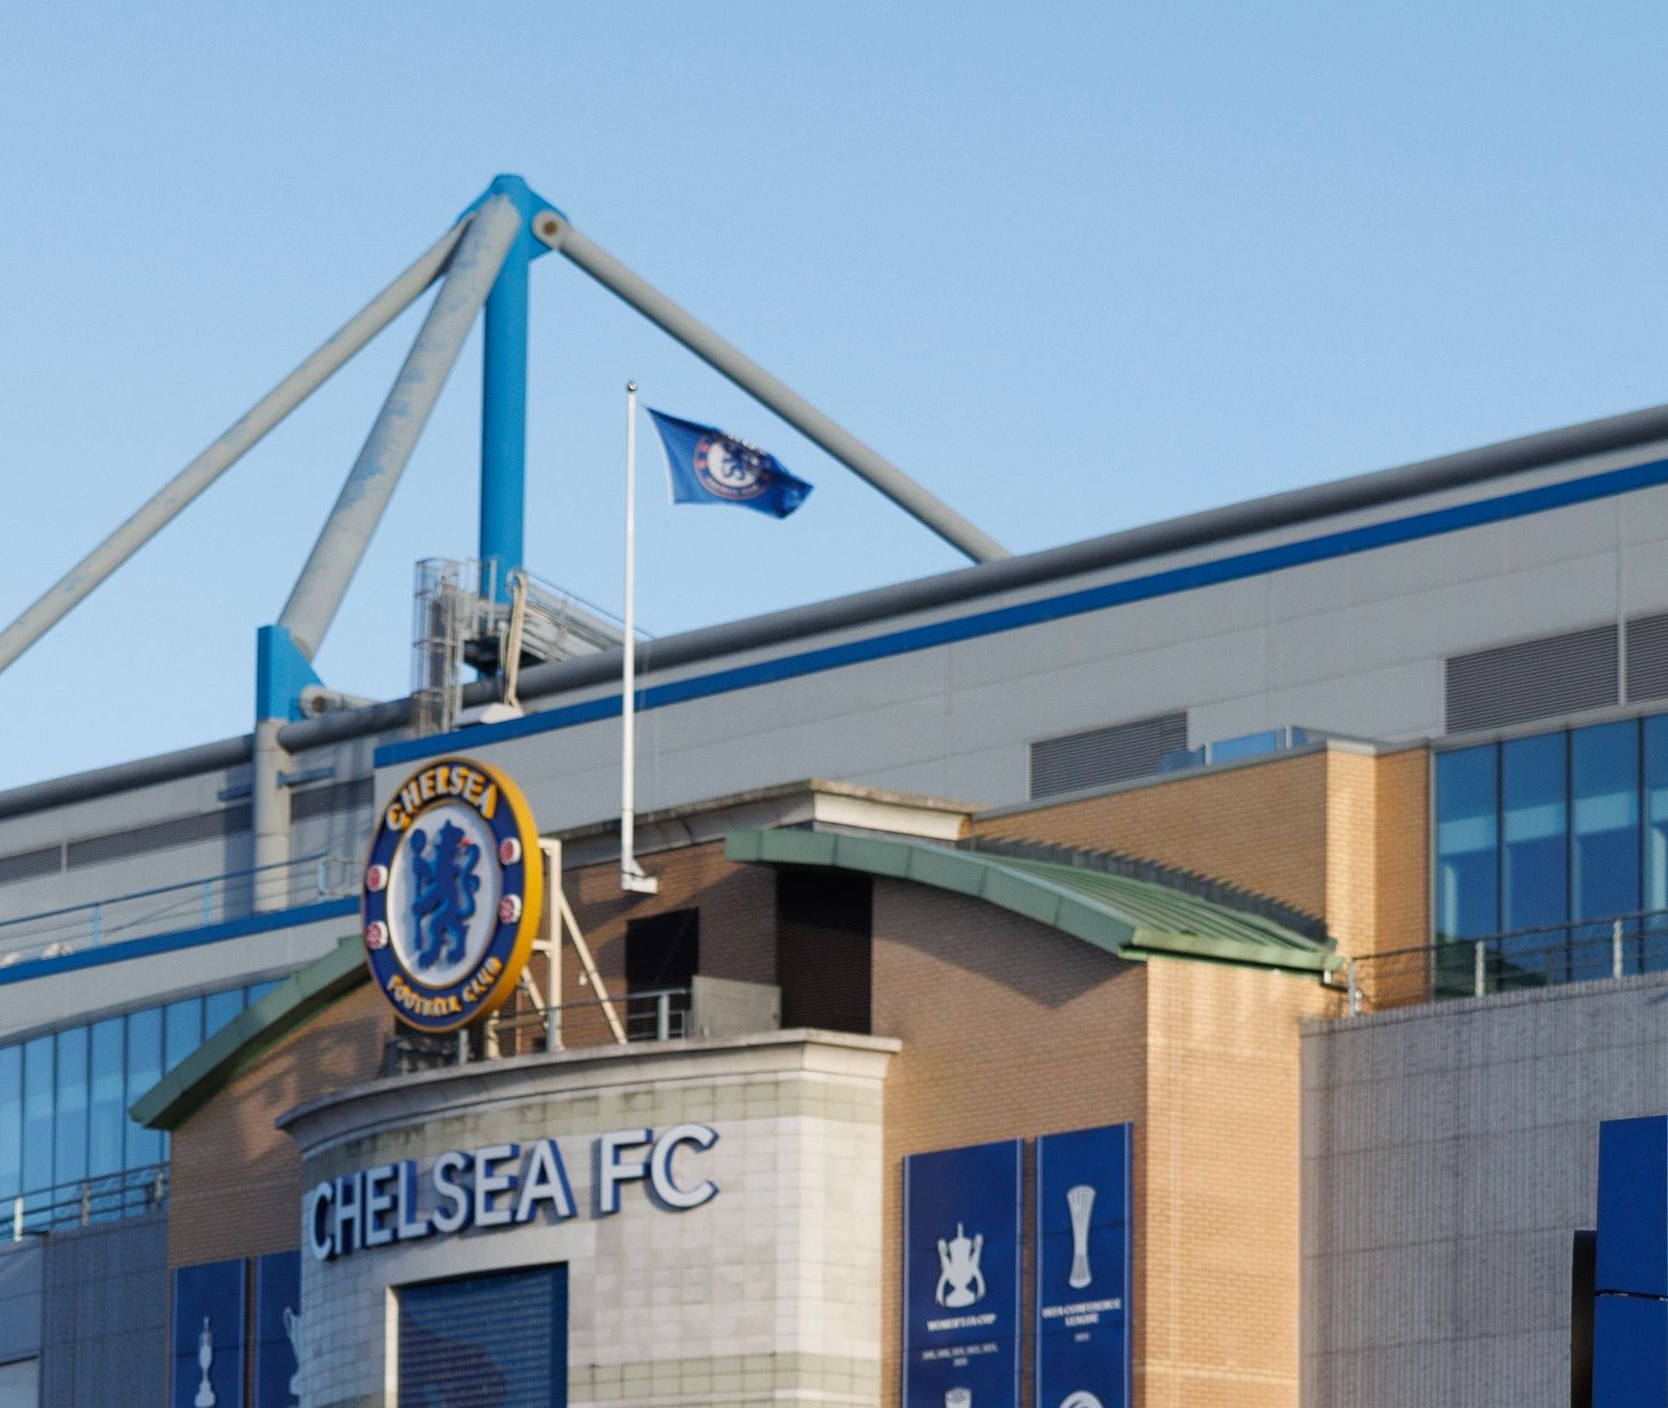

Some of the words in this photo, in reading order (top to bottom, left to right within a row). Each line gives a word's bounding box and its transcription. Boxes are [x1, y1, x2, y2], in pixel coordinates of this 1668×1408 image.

[387, 766, 497, 832] CHELSEA
[387, 973, 461, 1018] FOOTBALL
[462, 956, 503, 1005] CLUB
[309, 1139, 577, 1262] CHELSEA
[595, 1124, 720, 1213] FC
